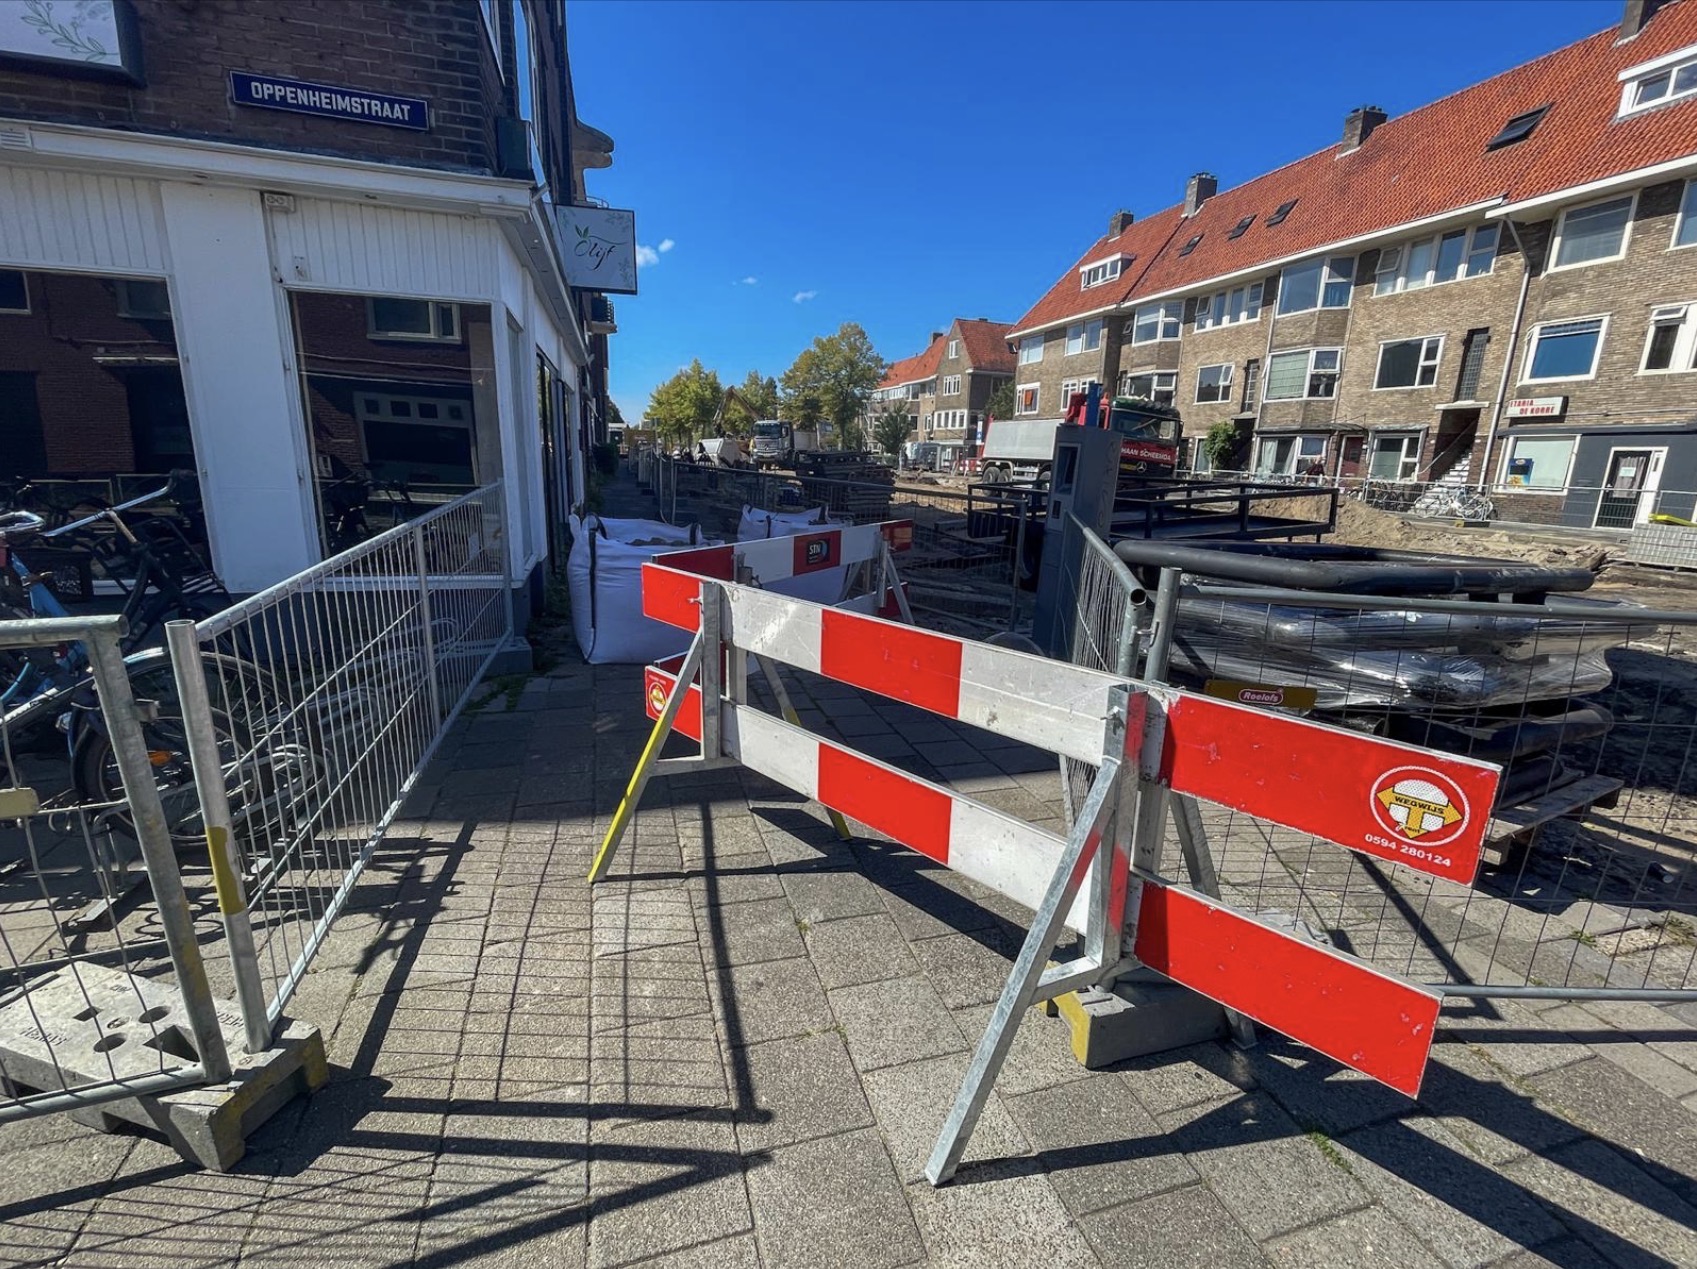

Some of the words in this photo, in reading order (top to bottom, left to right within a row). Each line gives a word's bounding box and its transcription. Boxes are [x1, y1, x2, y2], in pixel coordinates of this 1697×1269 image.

[250, 81, 410, 121] OPPENHEIMSTRAAT
[574, 239, 616, 271] Olijf
[1243, 691, 1279, 702] Roelofs
[1395, 796, 1444, 815] WEGWIJS
[1365, 834, 1397, 850] 0594
[1400, 845, 1452, 867] 280124
